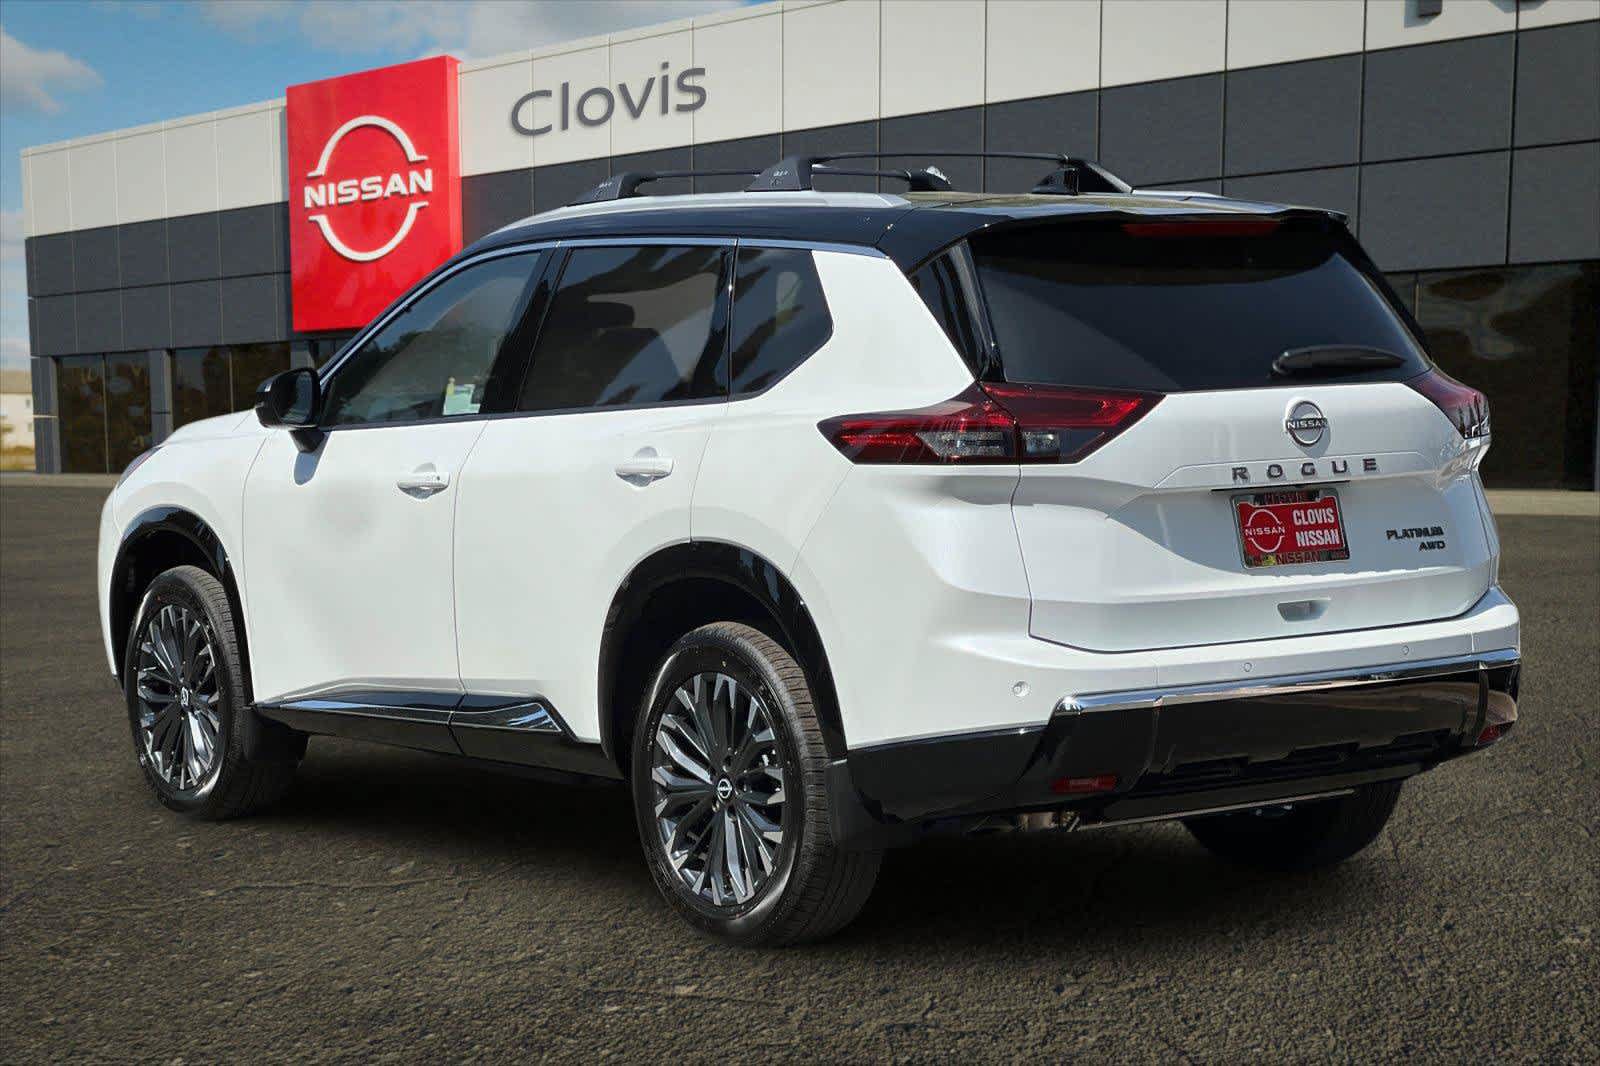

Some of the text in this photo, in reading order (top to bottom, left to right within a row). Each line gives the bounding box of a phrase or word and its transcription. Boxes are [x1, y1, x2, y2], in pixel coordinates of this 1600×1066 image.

[510, 61, 708, 137] Clovis
[303, 168, 434, 209] NISSAN
[1231, 457, 1378, 481] ROGUE
[1292, 507, 1335, 526] CLOVIS
[1244, 526, 1286, 536] NISSAN
[1295, 528, 1340, 547] NISSAN
[1386, 526, 1445, 540] PLATINUM
[1419, 540, 1446, 551] AWD
